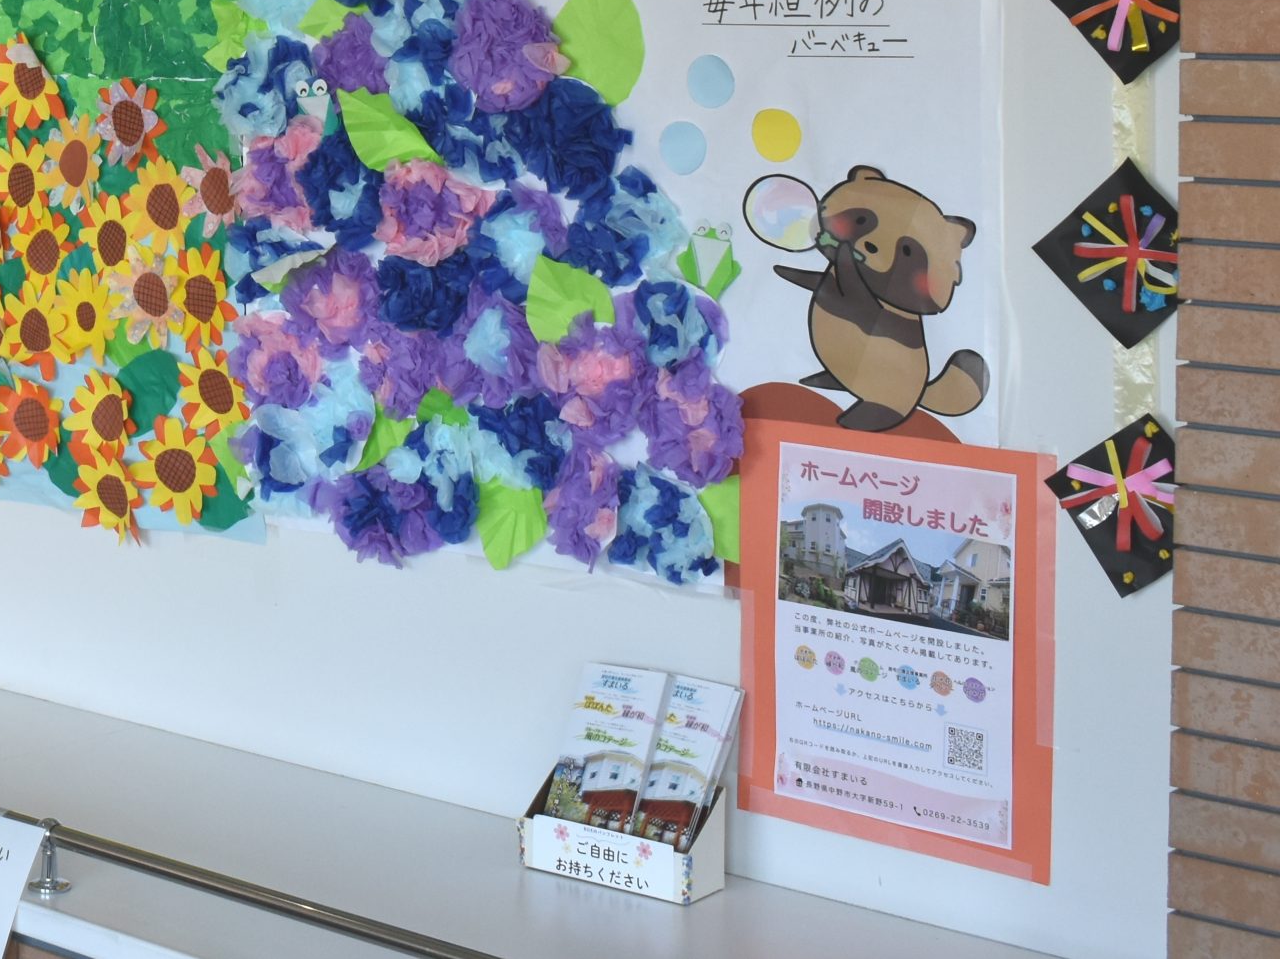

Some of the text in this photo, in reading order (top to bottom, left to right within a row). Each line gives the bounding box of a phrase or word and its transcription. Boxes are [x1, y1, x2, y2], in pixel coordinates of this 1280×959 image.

[791, 30, 908, 54] バーベキュー
[800, 461, 921, 496] ホームページ
[863, 498, 989, 537] 開設しました
[794, 612, 984, 655] この度、弊社の公式ホームページを開設しました。
[796, 701, 862, 722] ホームページURL
[849, 688, 932, 712] アクセスはこちらから
[813, 718, 932, 750] https://nakano-smile.com
[795, 761, 867, 786] 有限会社すまいる
[923, 808, 990, 830] 0269-22-3539
[577, 841, 628, 864] ご自由に
[556, 857, 649, 889] お持ちください
